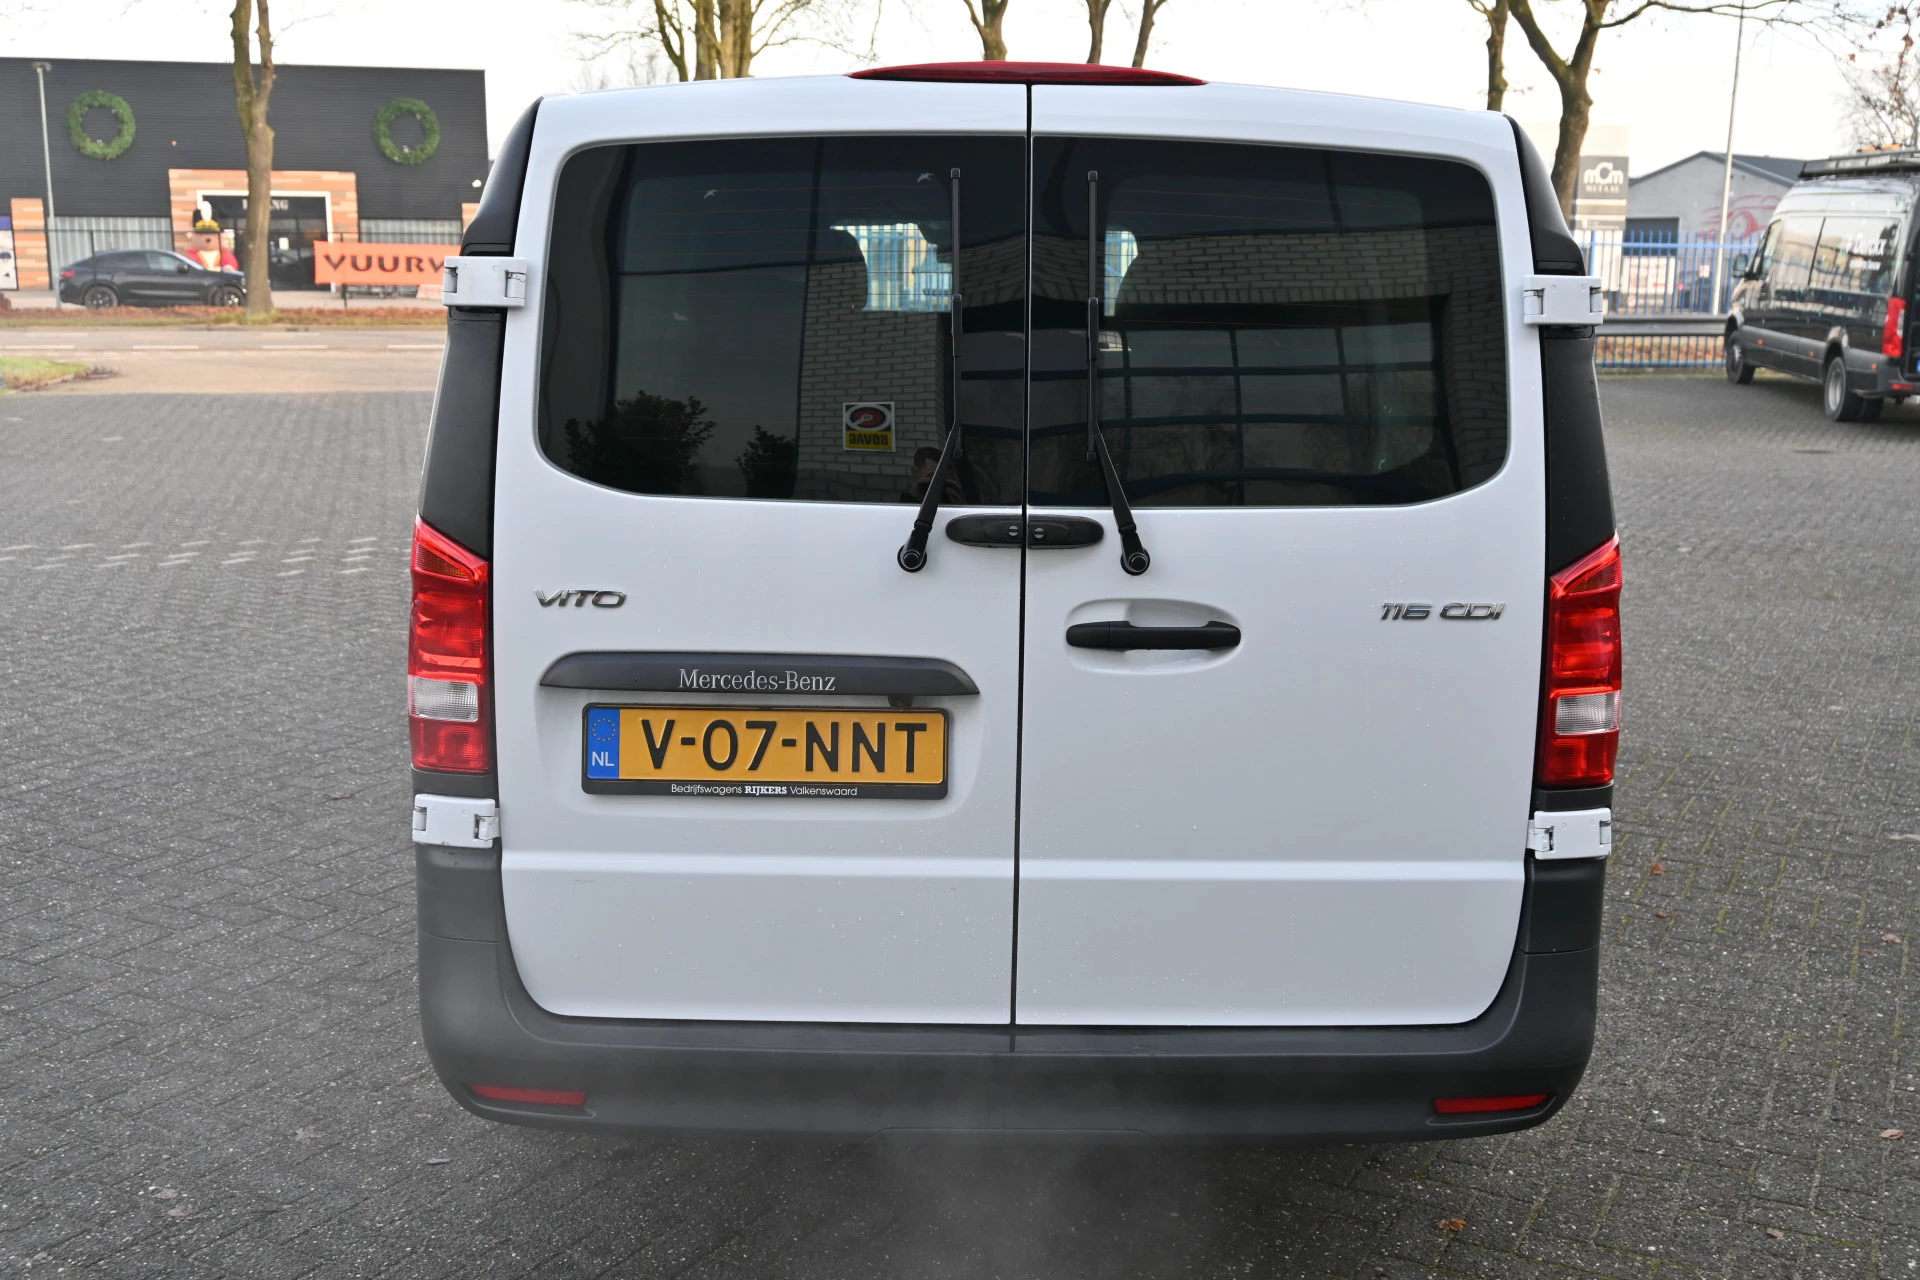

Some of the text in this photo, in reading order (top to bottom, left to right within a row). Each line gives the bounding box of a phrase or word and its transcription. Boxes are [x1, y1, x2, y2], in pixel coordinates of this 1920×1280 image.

[534, 589, 626, 608] VITO
[1381, 602, 1506, 621] 116 CDI
[679, 668, 836, 691] Mercedes-Benz
[640, 718, 928, 774] V-07-NNT
[591, 751, 615, 767] NL
[671, 784, 858, 796] Bedrijfswagens RIJKERS Valkenswaard
